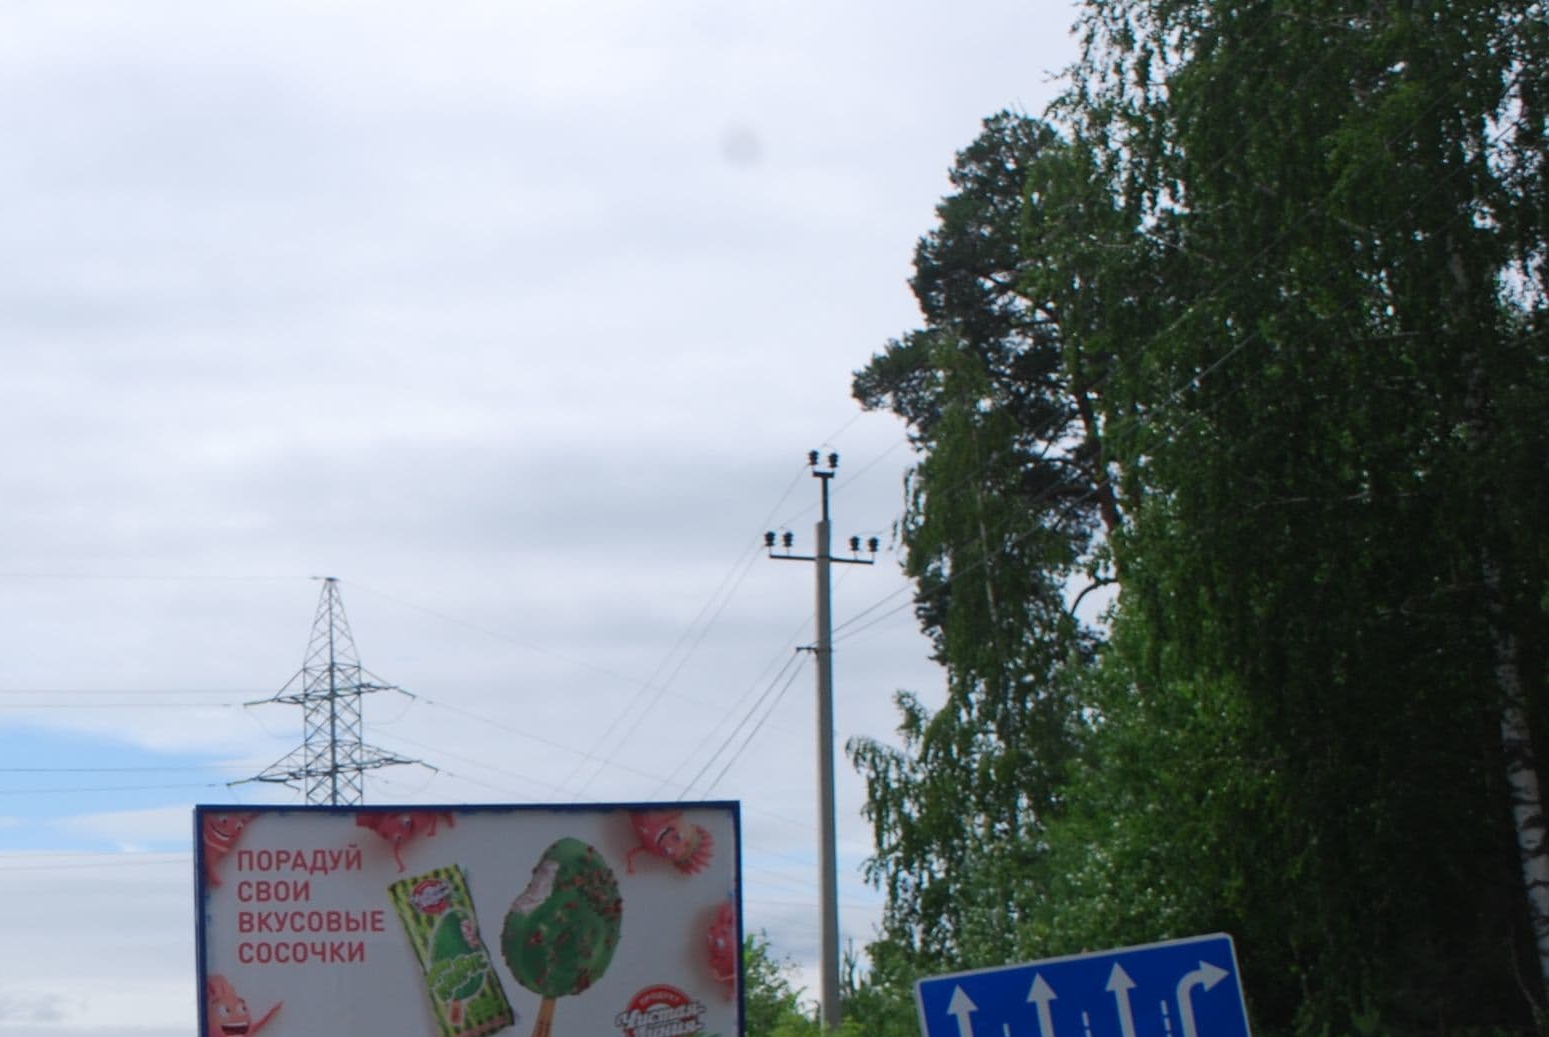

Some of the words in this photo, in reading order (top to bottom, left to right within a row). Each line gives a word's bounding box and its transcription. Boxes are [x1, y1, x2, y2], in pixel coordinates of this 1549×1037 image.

[237, 843, 363, 875] ПОРАДУЙ
[237, 880, 311, 902] СВОИ
[238, 910, 386, 933] ВКУСОВЫЕ
[238, 941, 366, 964] СОСОЧКИ
